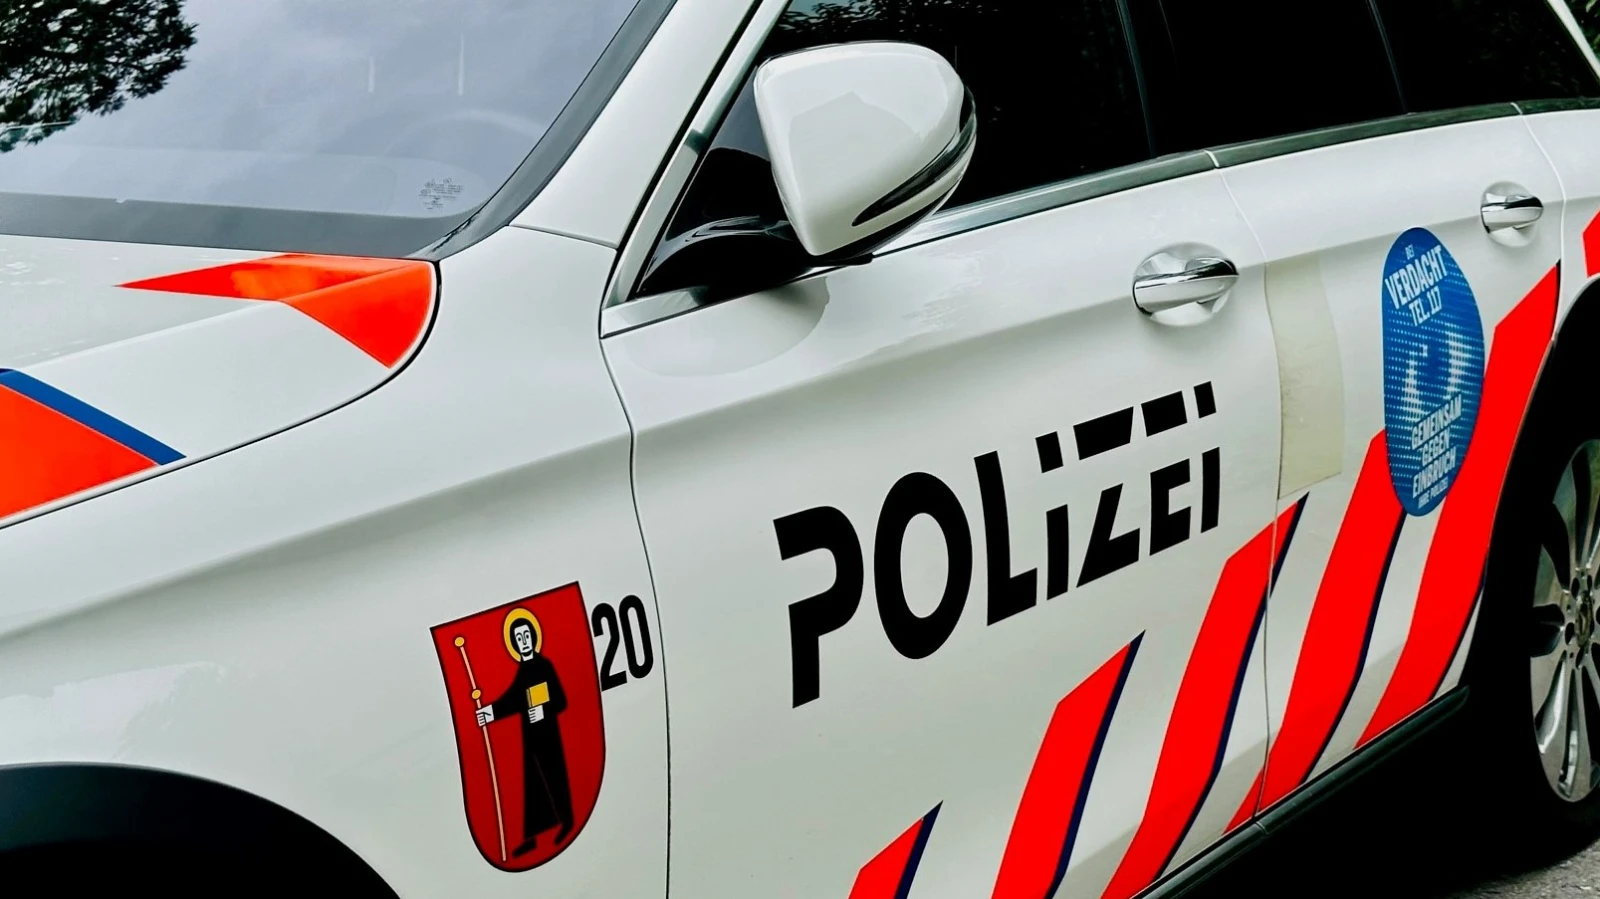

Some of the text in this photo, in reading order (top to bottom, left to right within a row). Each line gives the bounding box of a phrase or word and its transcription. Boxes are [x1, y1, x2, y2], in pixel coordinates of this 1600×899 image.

[1384, 244, 1448, 310] VERDACHT
[1405, 244, 1415, 260] BEI
[1408, 285, 1442, 327] TEL. 117
[1411, 393, 1462, 450] GEMEINSAM
[1422, 426, 1450, 467] GEGEN
[1412, 446, 1457, 499] EINBRUCH
[773, 381, 1220, 709] POLIZEI
[591, 594, 654, 692] 20
